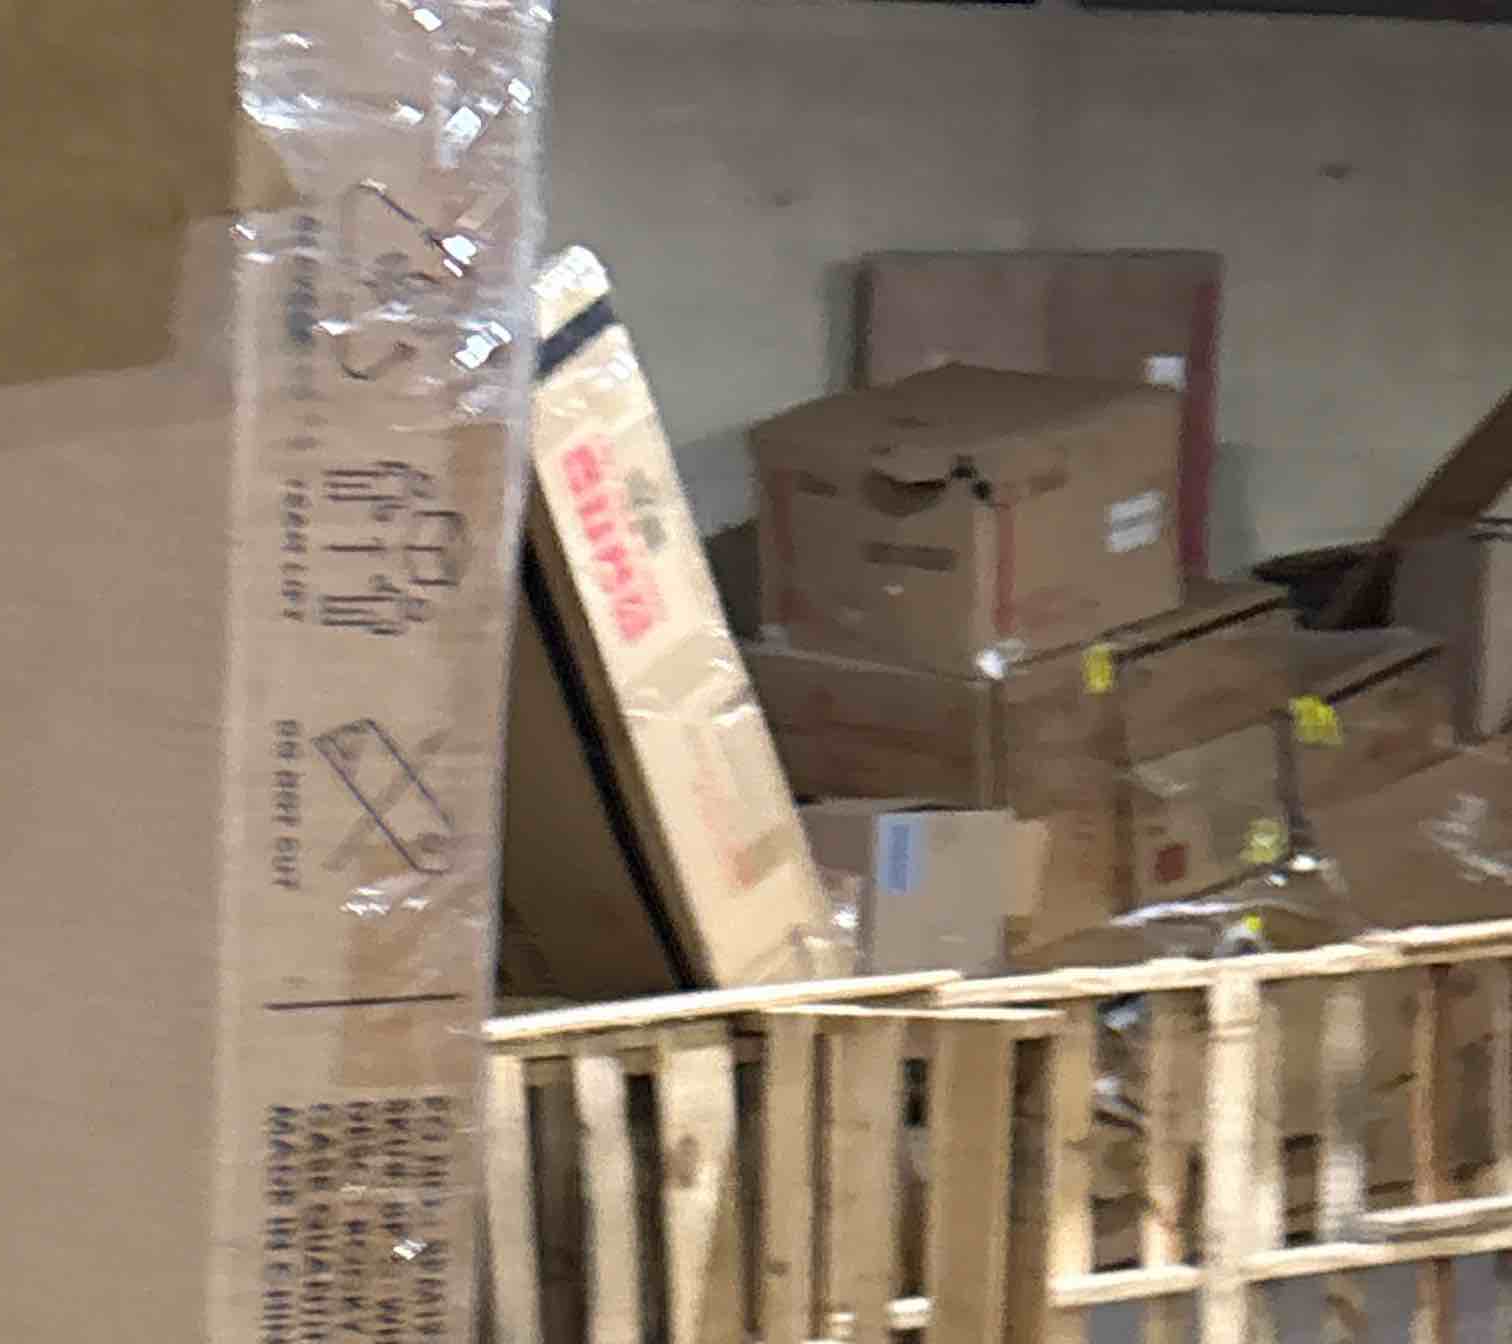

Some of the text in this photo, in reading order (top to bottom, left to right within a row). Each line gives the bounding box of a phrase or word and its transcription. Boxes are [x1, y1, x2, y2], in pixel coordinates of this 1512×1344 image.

[282, 476, 309, 553] TEAM
[280, 562, 309, 622] LIFT
[270, 836, 304, 890] CUT
[266, 1103, 299, 1204] MADE
[264, 1216, 297, 1250] IN
